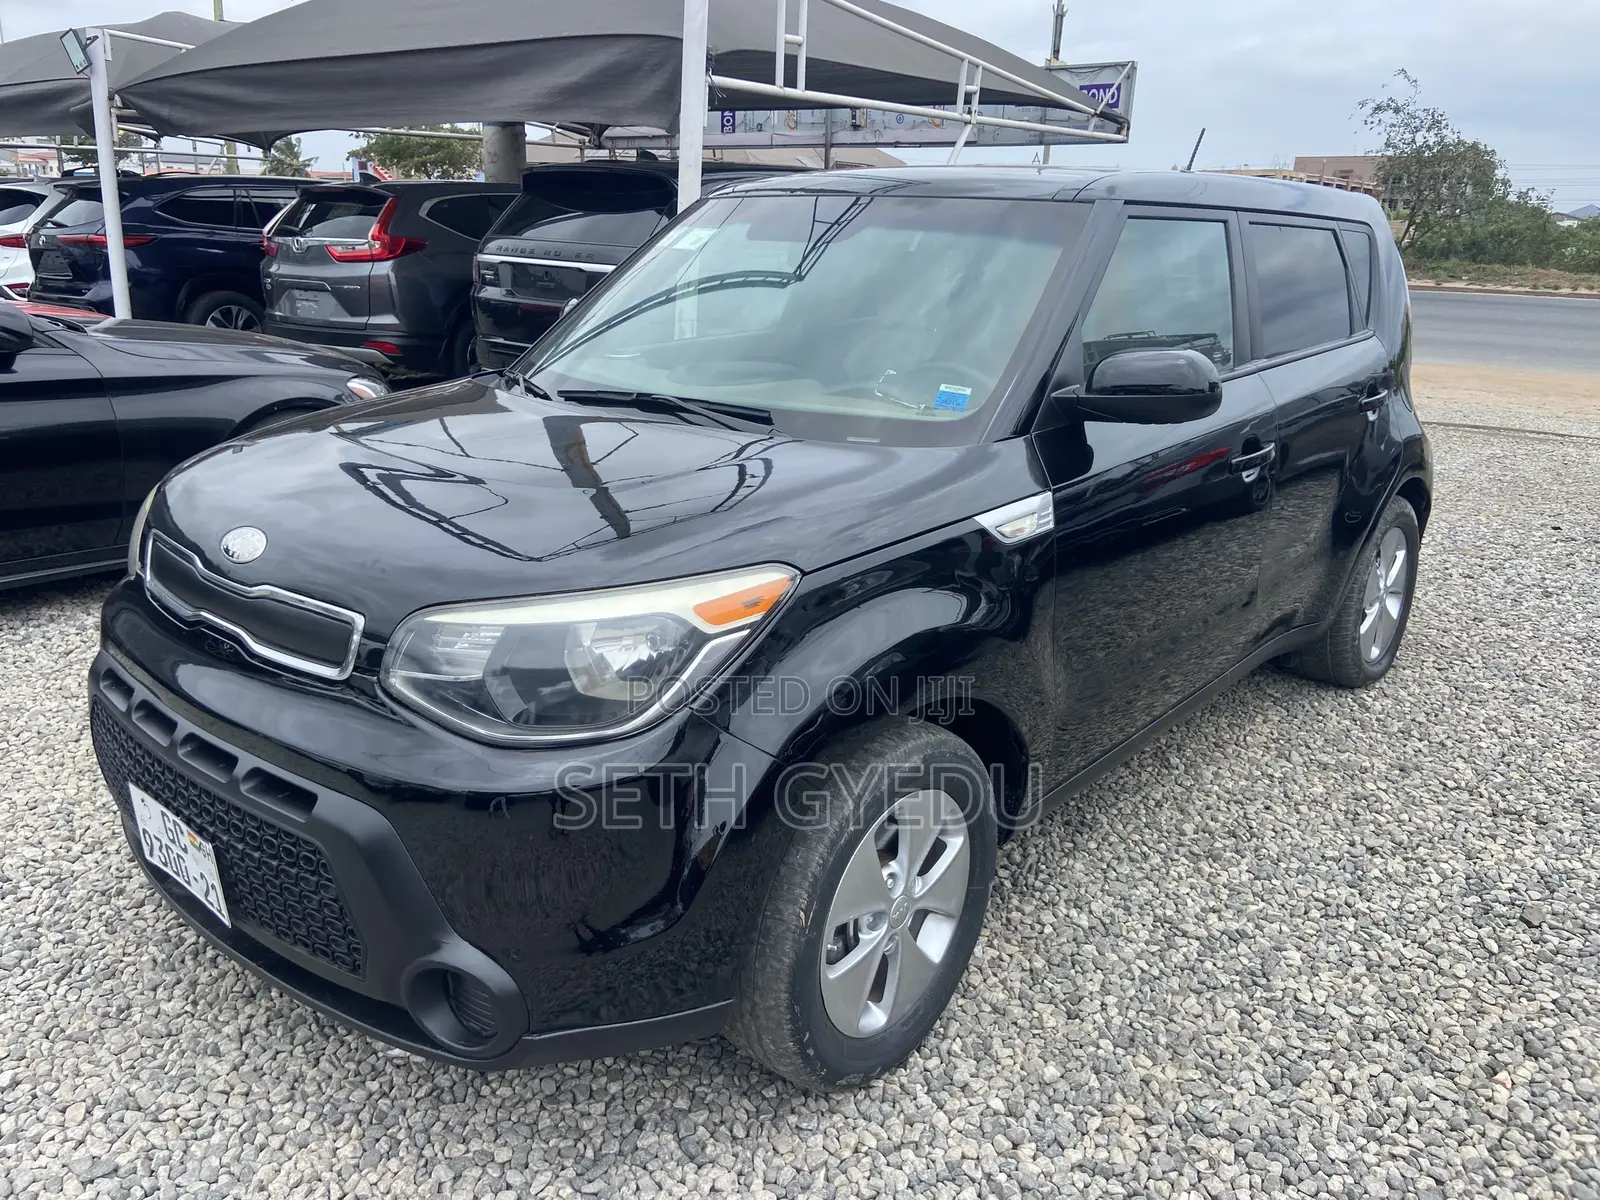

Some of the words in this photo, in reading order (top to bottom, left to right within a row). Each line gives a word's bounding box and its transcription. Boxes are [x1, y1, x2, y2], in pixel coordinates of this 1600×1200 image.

[1082, 88, 1117, 104] OND
[496, 246, 535, 255] RANGE
[544, 249, 595, 260] ROER
[161, 809, 189, 854] GC
